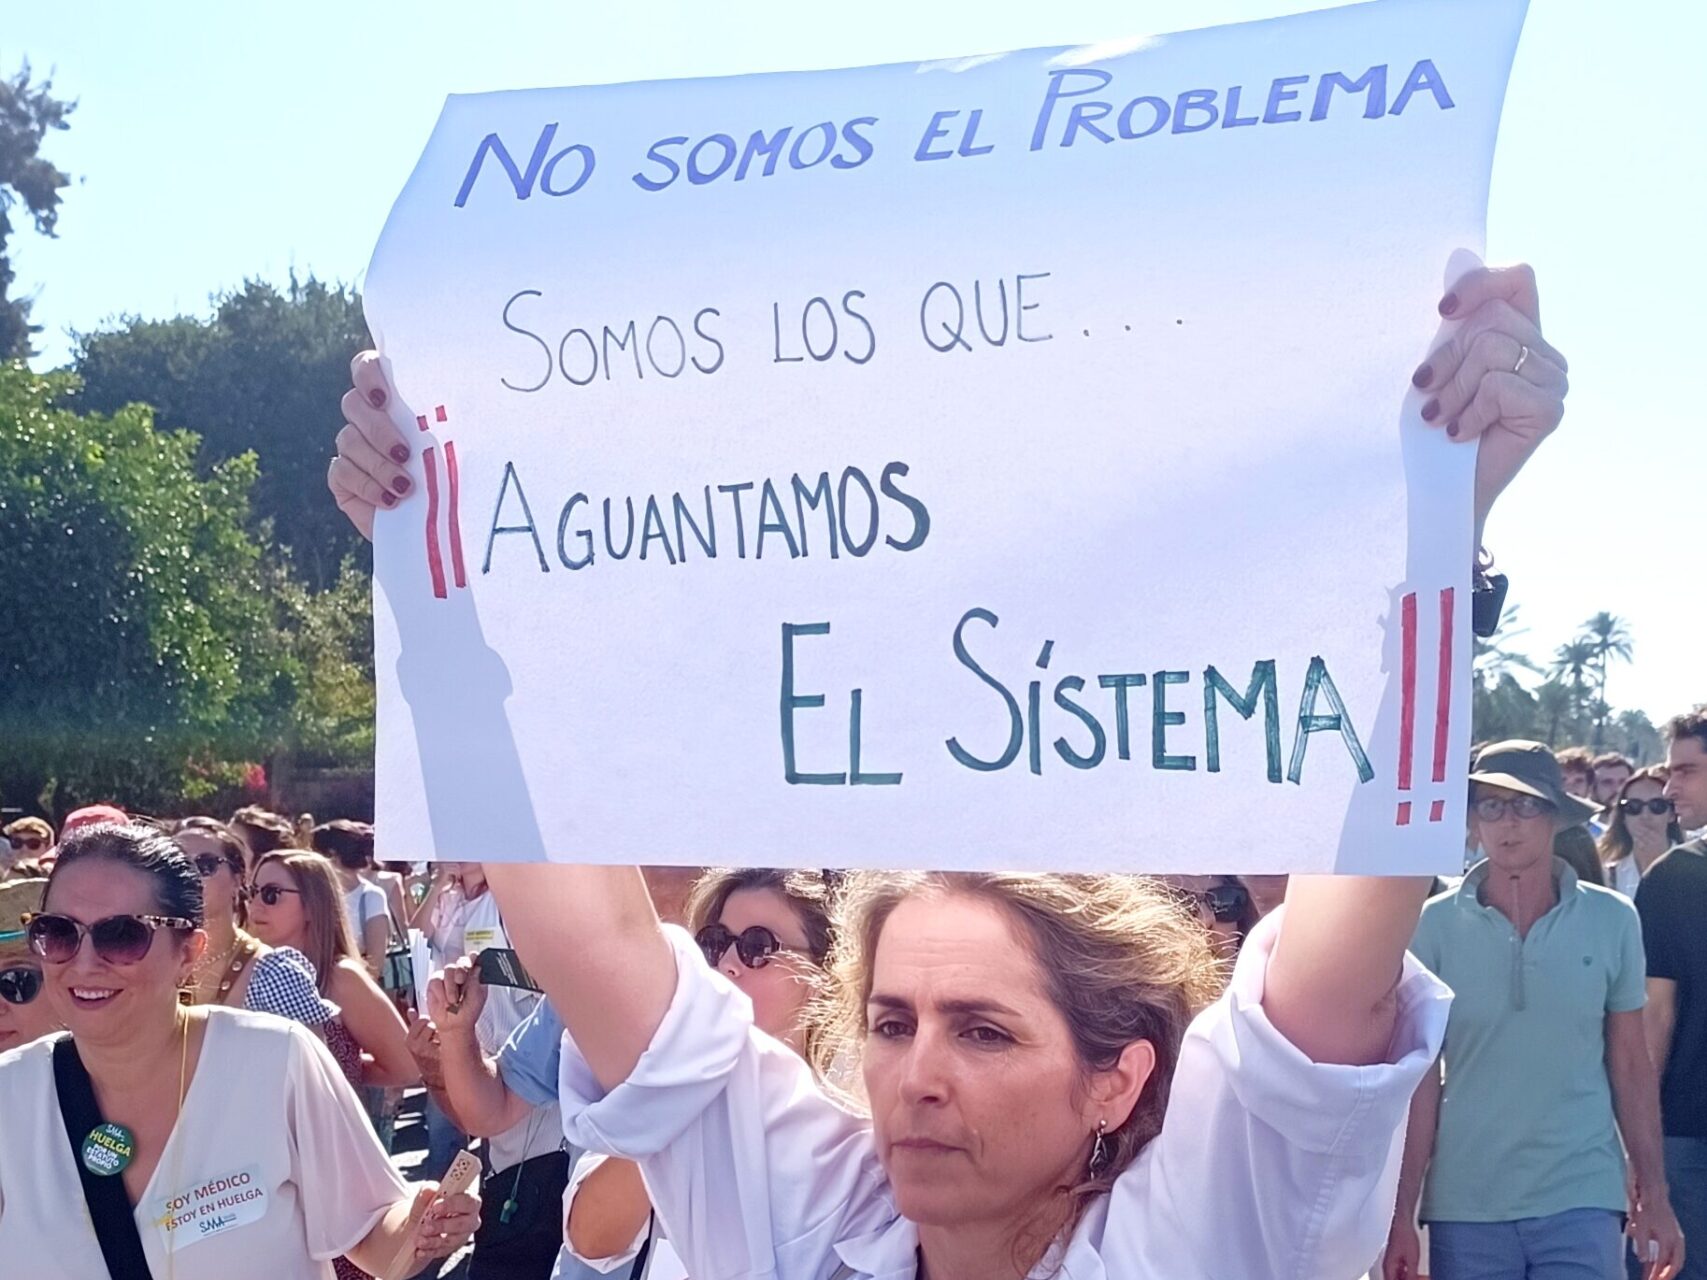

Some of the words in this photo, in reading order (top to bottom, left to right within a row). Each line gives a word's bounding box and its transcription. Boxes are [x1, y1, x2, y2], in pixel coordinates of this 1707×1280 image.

[453, 121, 597, 209] NO
[631, 116, 880, 192] SOMOS
[913, 109, 995, 162] EL
[1029, 59, 1456, 152] PROBLEMA
[500, 289, 725, 393] SOMOS
[773, 289, 876, 365] LOS
[779, 620, 904, 787] EL
[89, 1129, 131, 1157] HUELGA
[165, 1193, 191, 1214] SOY
[194, 1172, 251, 1201] MÉDICO
[199, 1203, 216, 1217] EN
[217, 1188, 264, 1210] HUELGA
